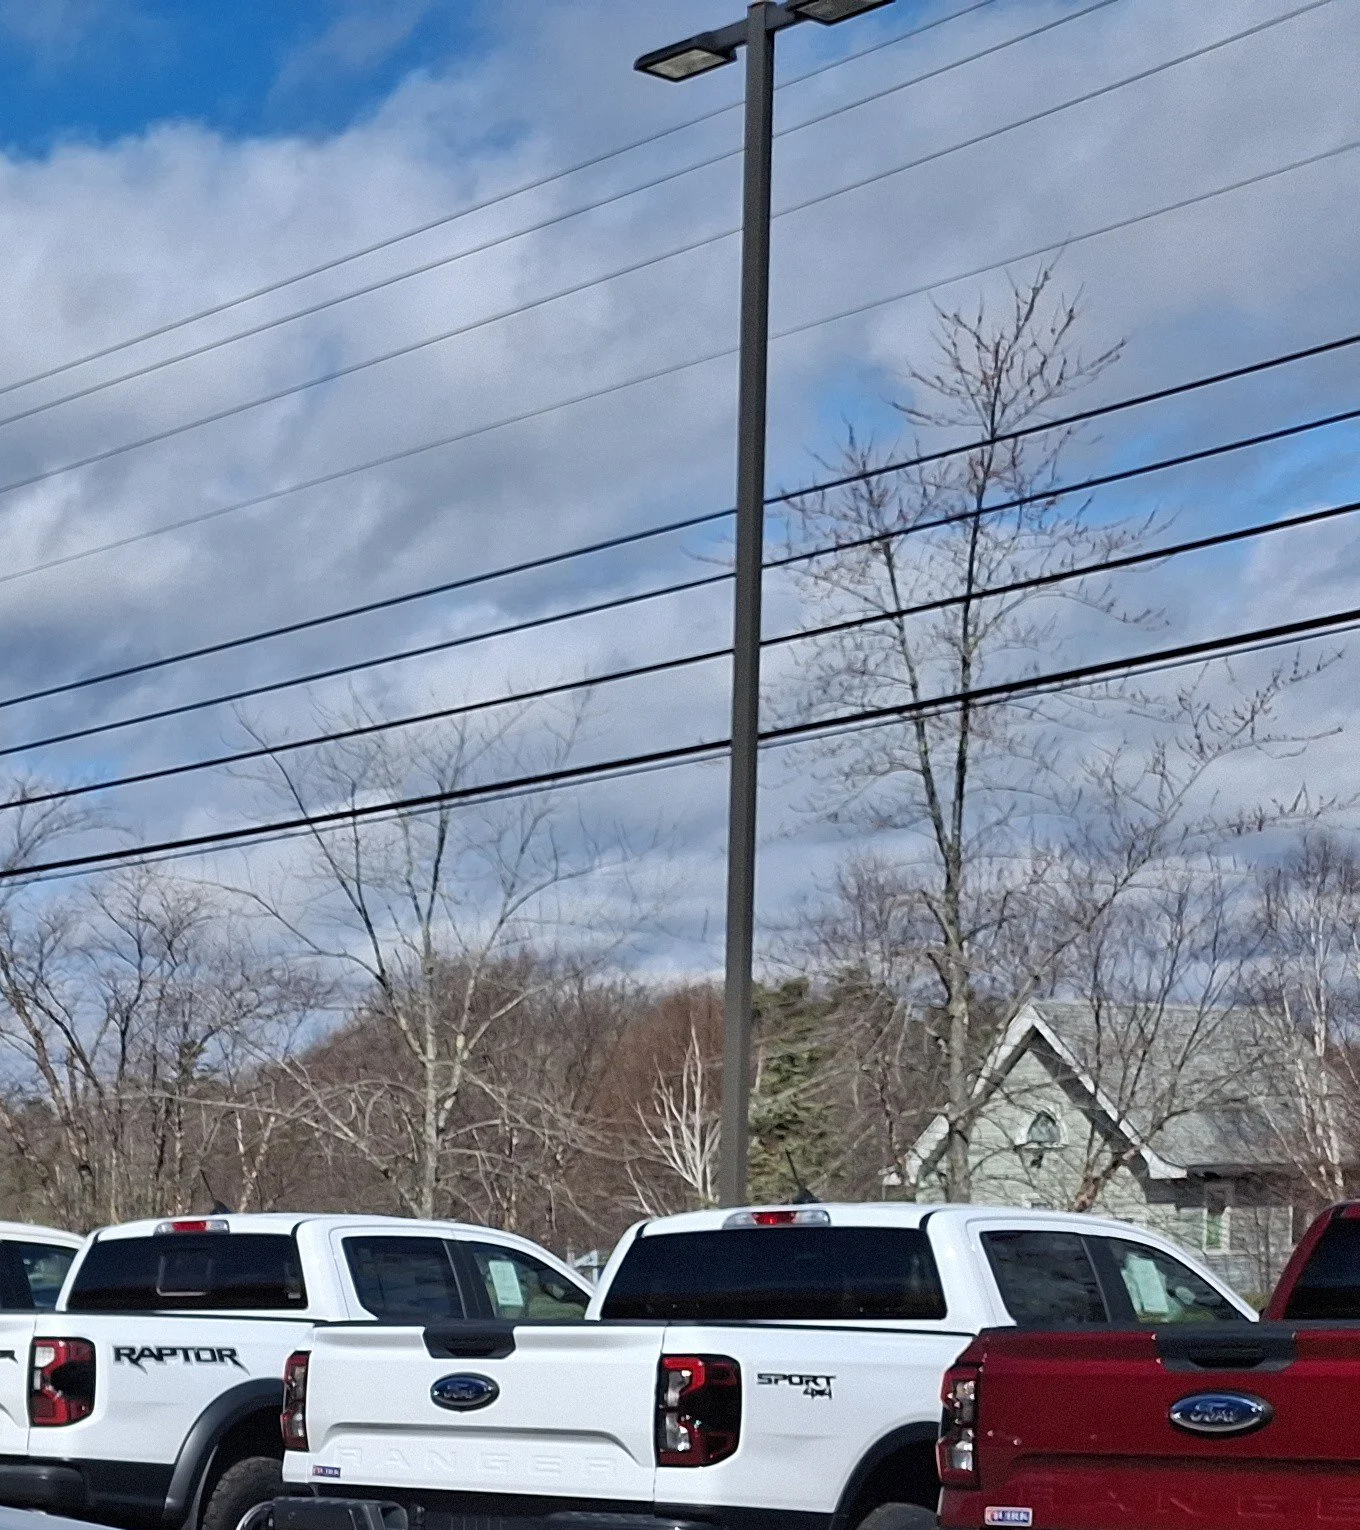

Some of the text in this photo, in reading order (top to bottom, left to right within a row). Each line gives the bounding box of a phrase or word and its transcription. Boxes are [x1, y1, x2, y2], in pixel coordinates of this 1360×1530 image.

[113, 1346, 250, 1376] RAPTOR
[757, 1373, 836, 1386] SPORT
[336, 1446, 618, 1477] RANGER
